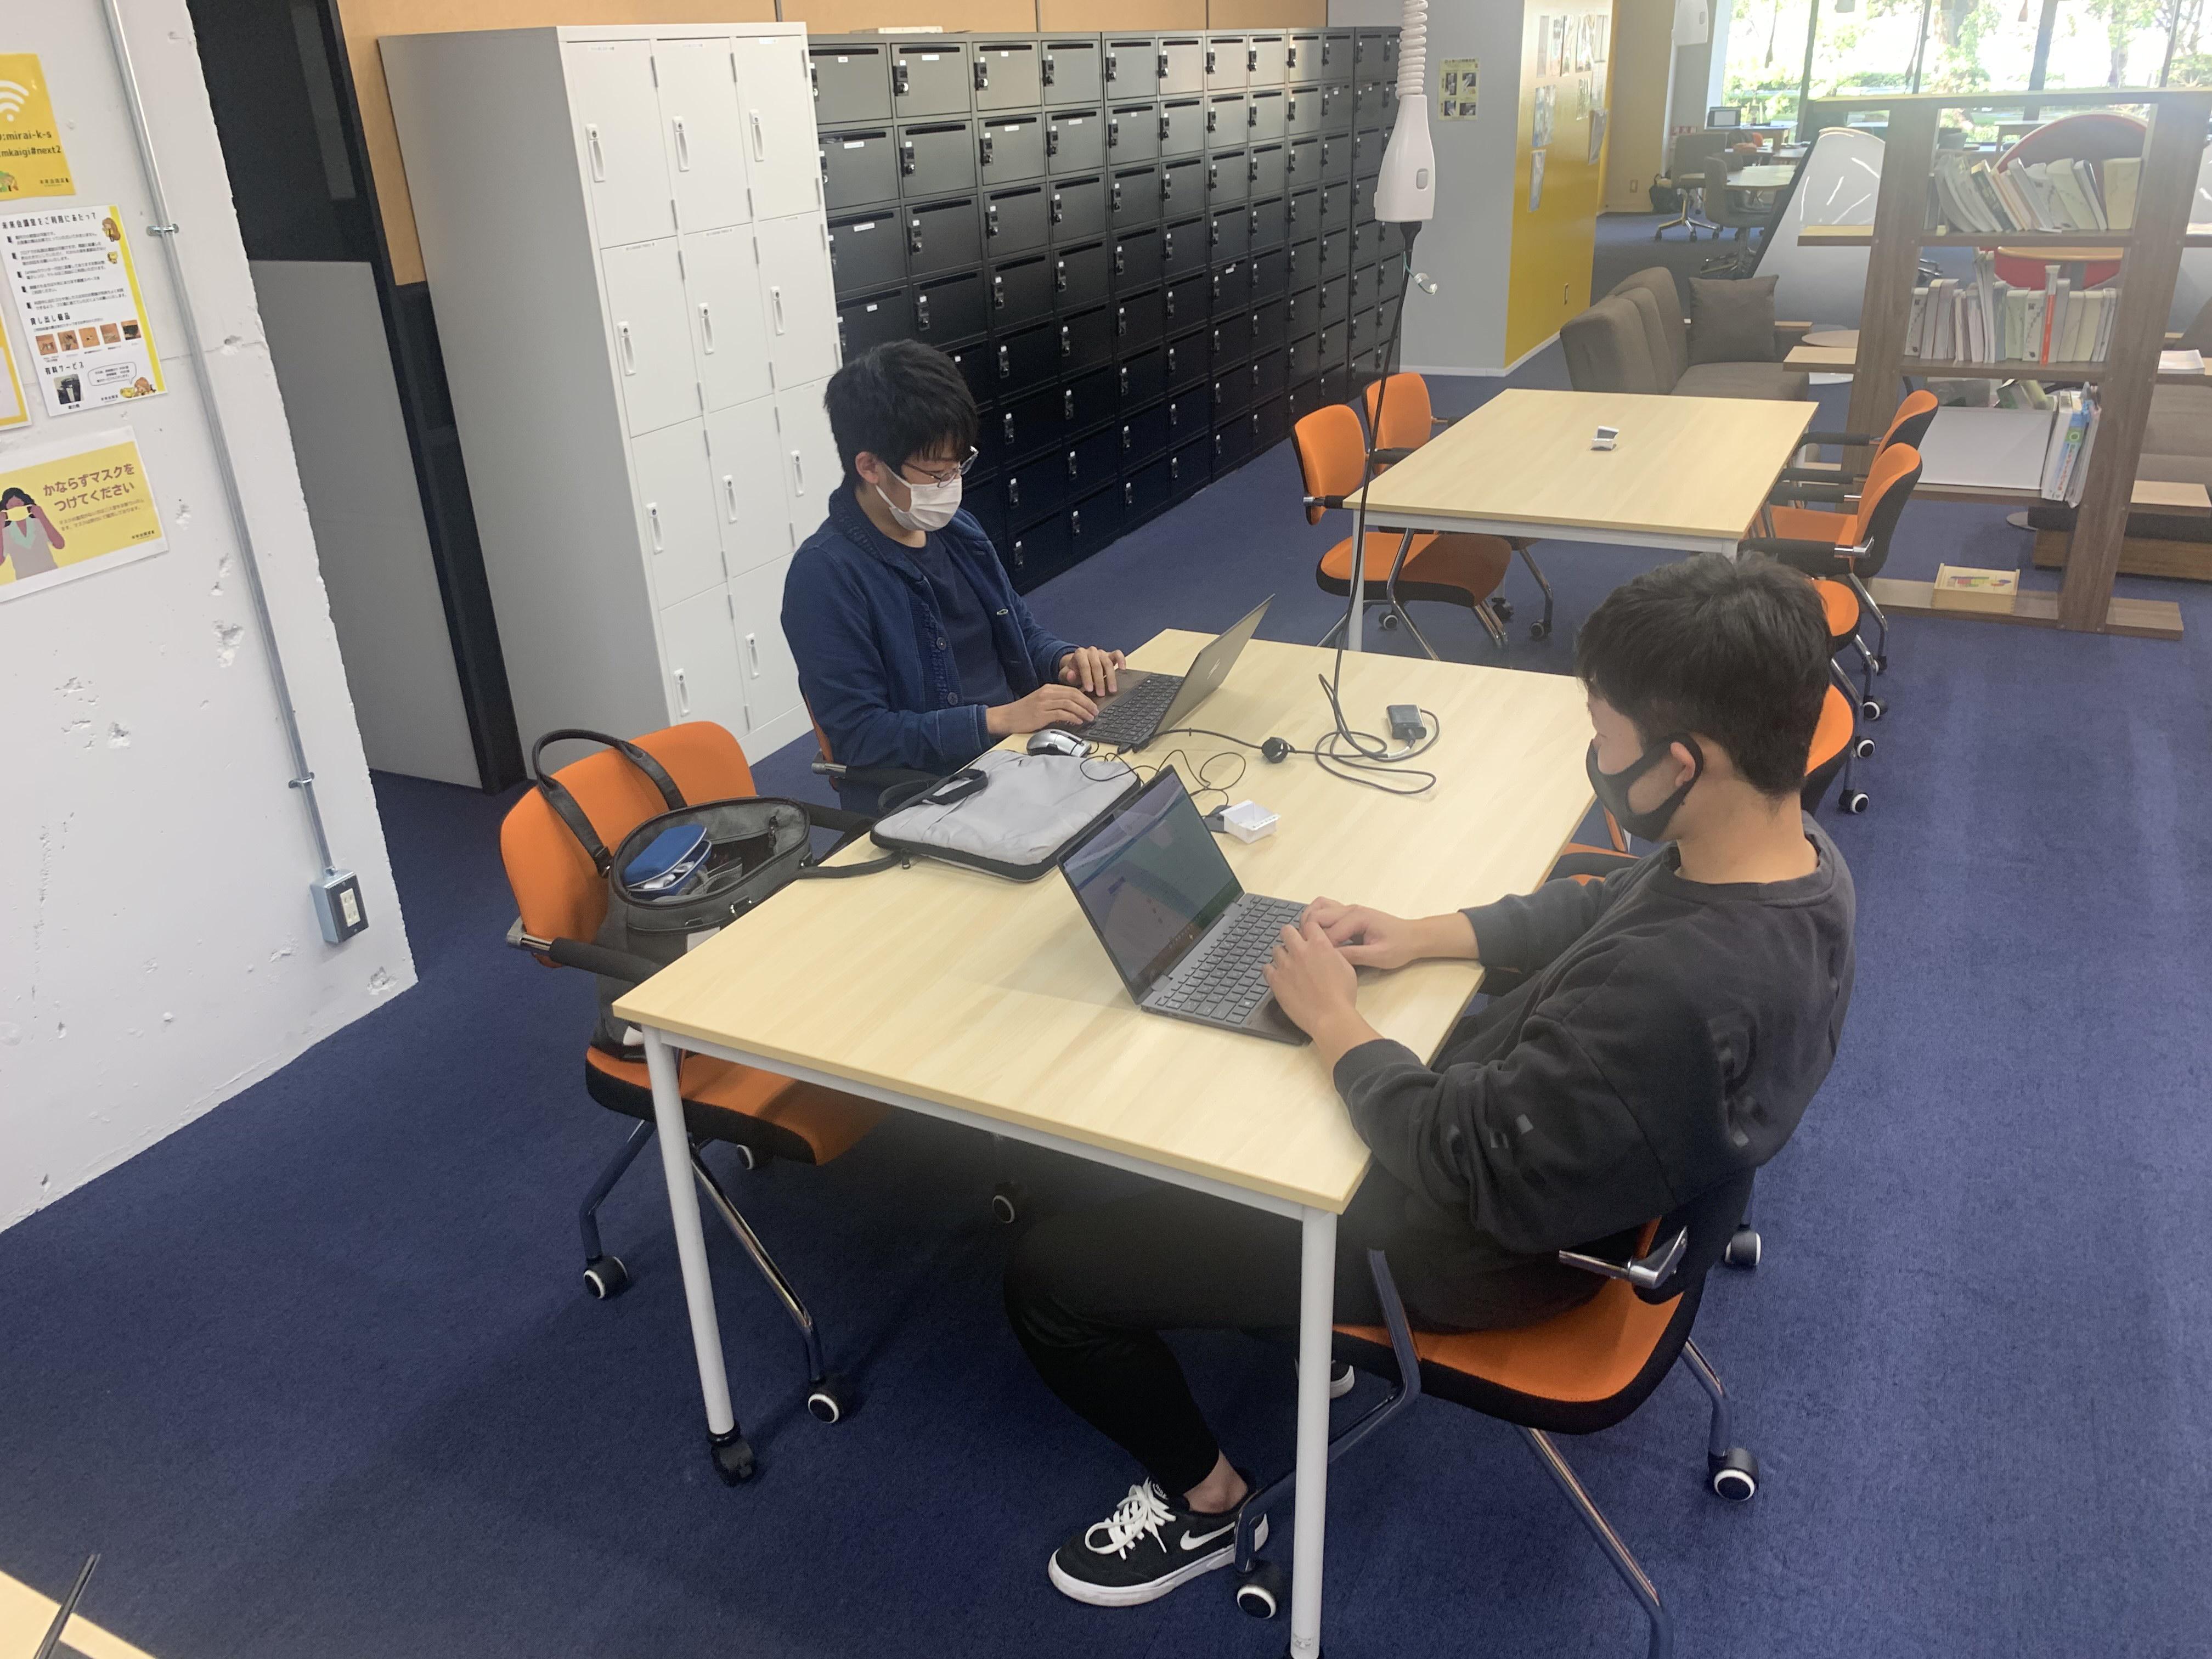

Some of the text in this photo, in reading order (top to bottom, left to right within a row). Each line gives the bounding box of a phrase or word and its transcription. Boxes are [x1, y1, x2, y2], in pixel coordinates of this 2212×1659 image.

[0, 145, 60, 158] mkaigi#next2
[45, 362, 84, 375] 有料サービス
[43, 464, 134, 496] かならずマスクを
[54, 482, 134, 511] つけてください
